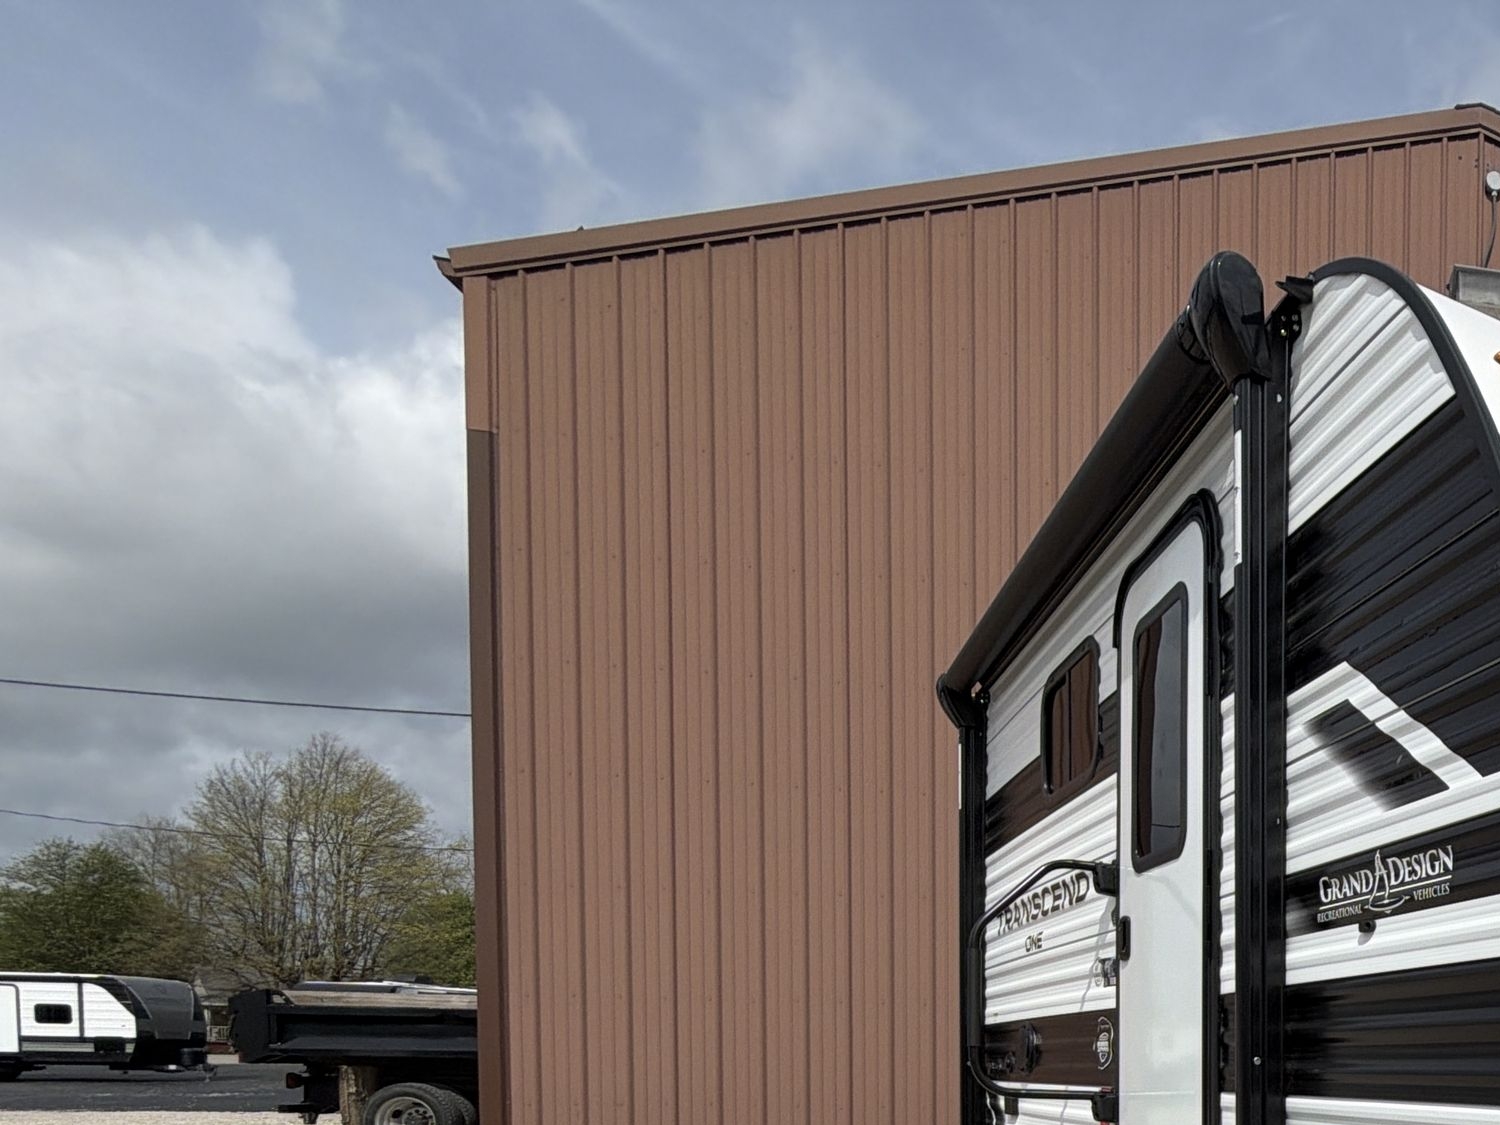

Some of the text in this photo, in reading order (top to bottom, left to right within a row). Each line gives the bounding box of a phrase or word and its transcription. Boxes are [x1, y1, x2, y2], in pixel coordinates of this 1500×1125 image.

[1319, 845, 1454, 903] GRAND DESIGN
[997, 871, 1089, 936] TRANSCEND
[1317, 882, 1450, 923] RECREATIONAL VEHICLES
[1025, 931, 1043, 952] ONE
